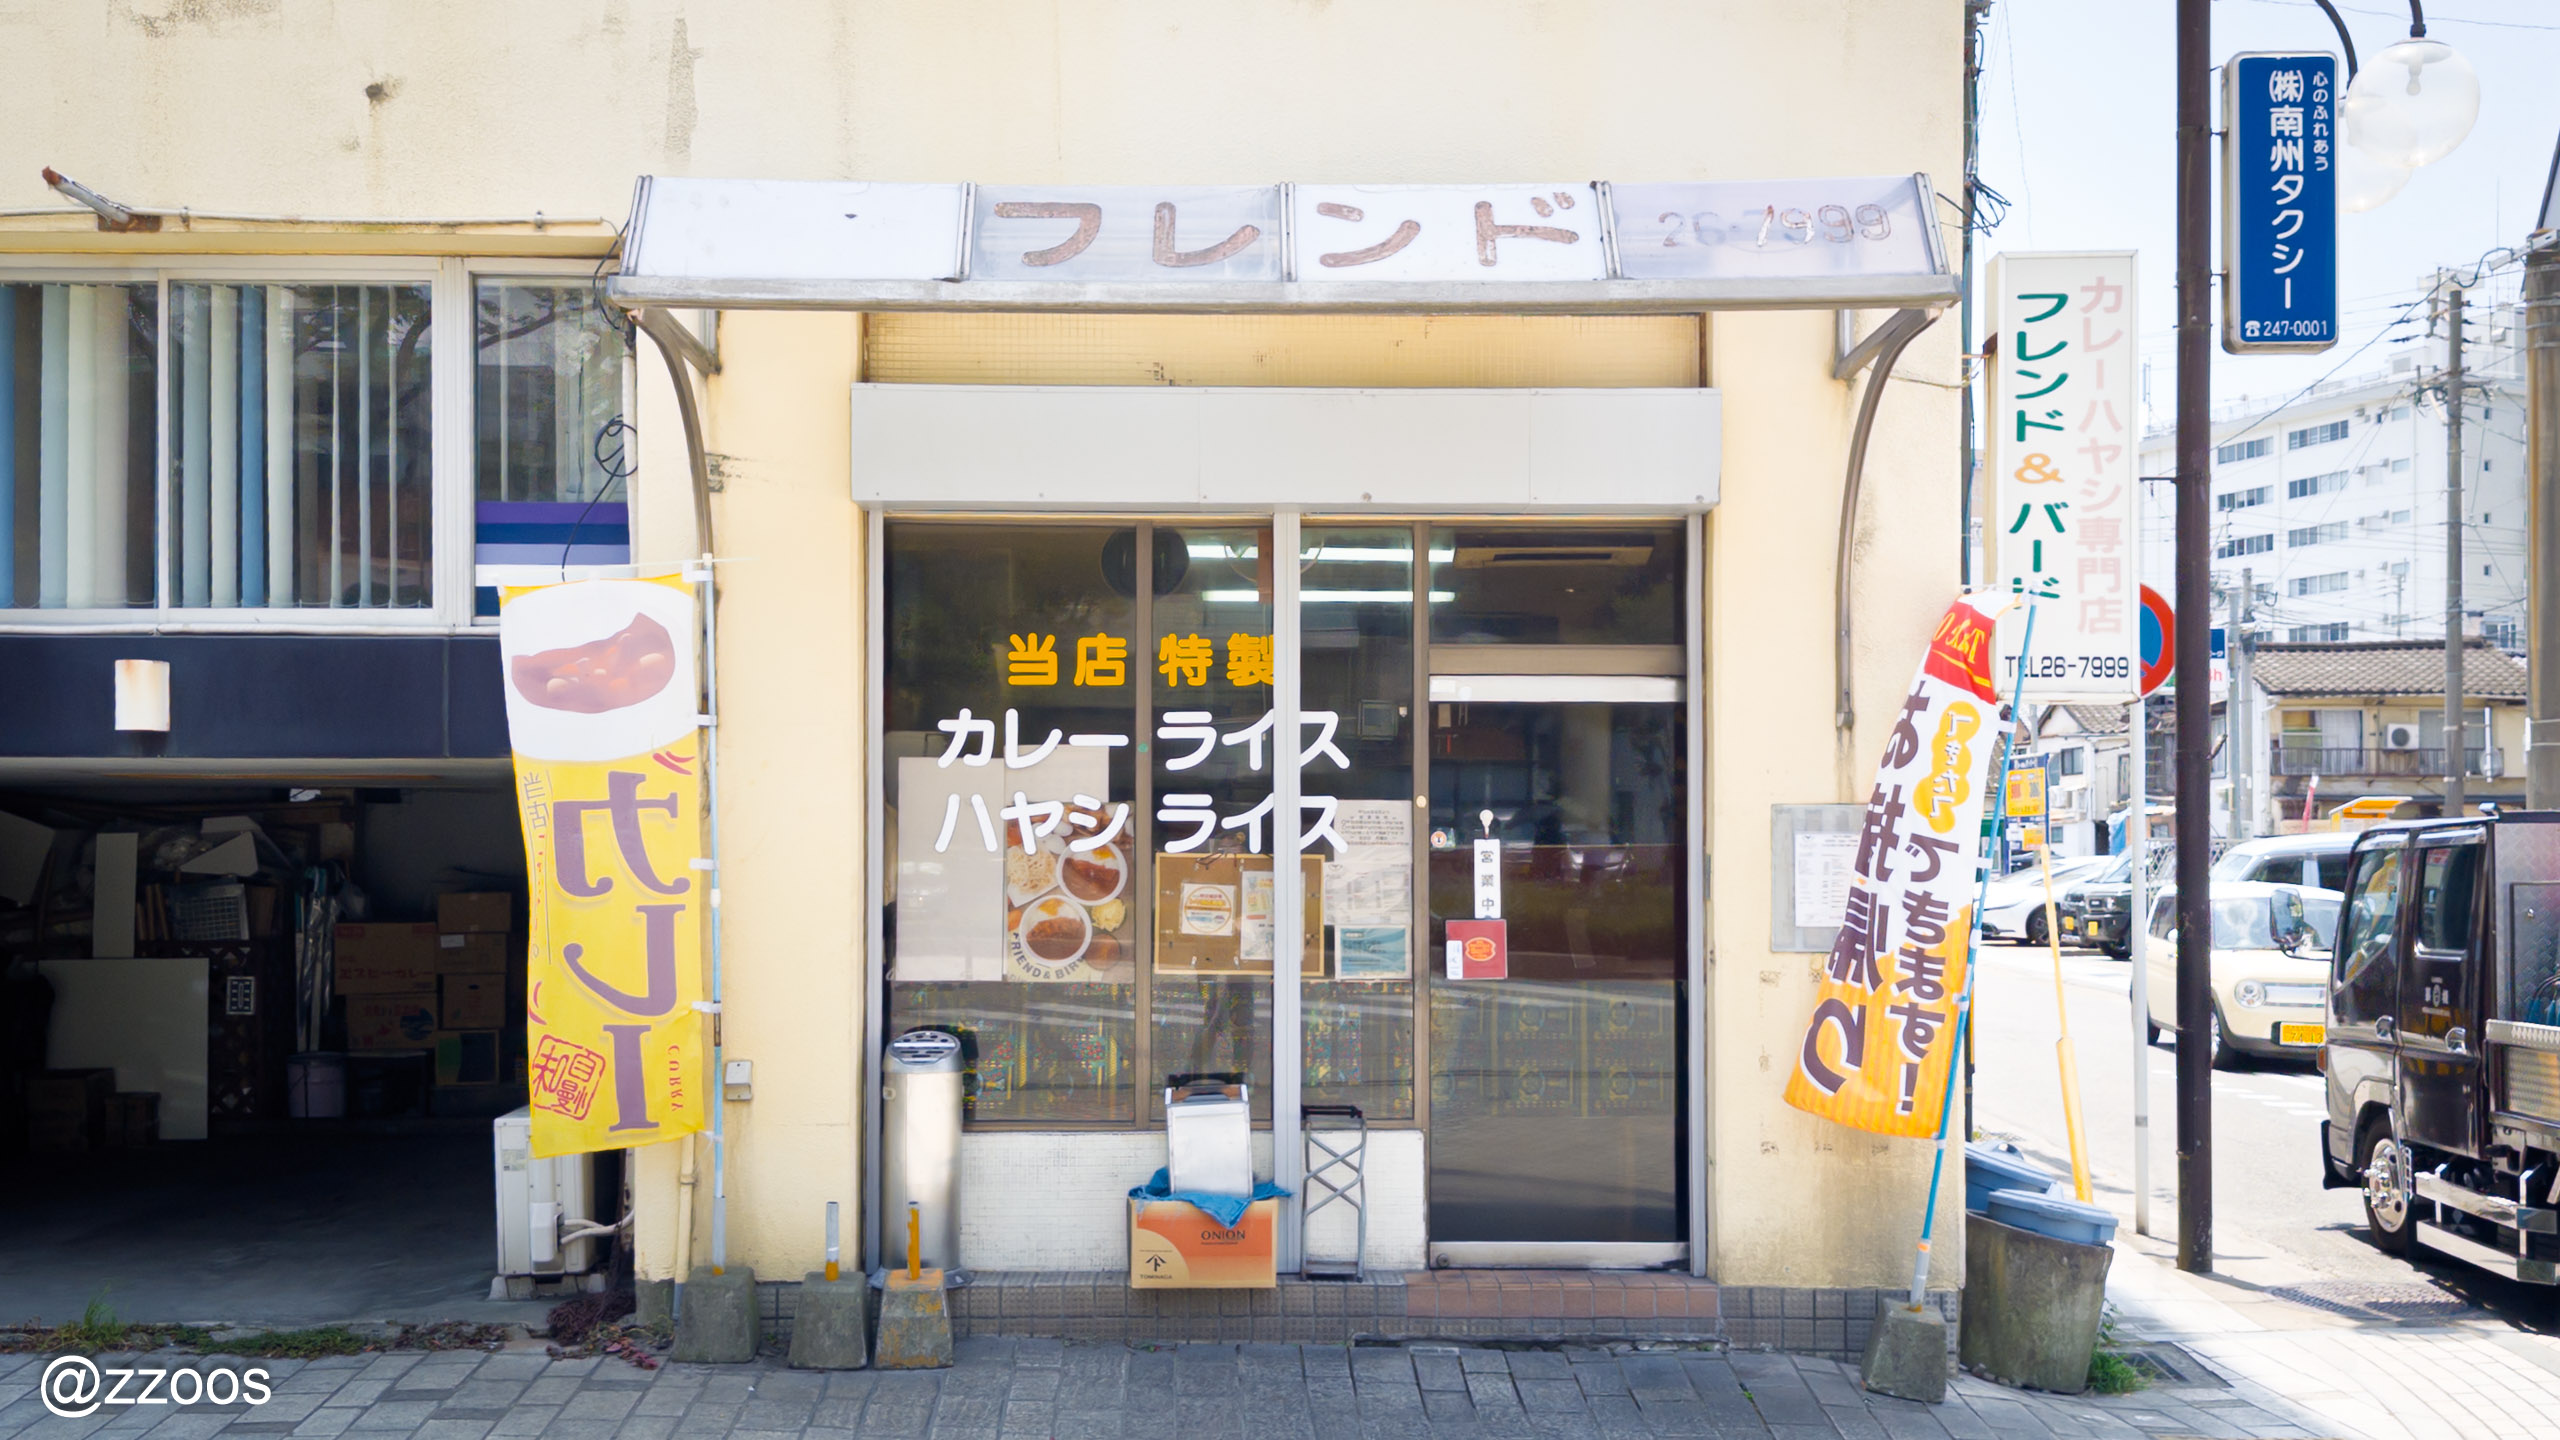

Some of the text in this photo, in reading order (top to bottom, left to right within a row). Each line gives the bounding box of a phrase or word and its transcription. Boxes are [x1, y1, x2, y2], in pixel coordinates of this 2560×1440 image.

[2312, 71, 2329, 171] 心のふれあう
[994, 190, 1580, 268] フレンド
[2263, 320, 2327, 336] 247-0001
[2074, 276, 2124, 634] カレーハヤシ専門店
[1480, 850, 1495, 911] 営業中
[1201, 1230, 1245, 1241] ONION
